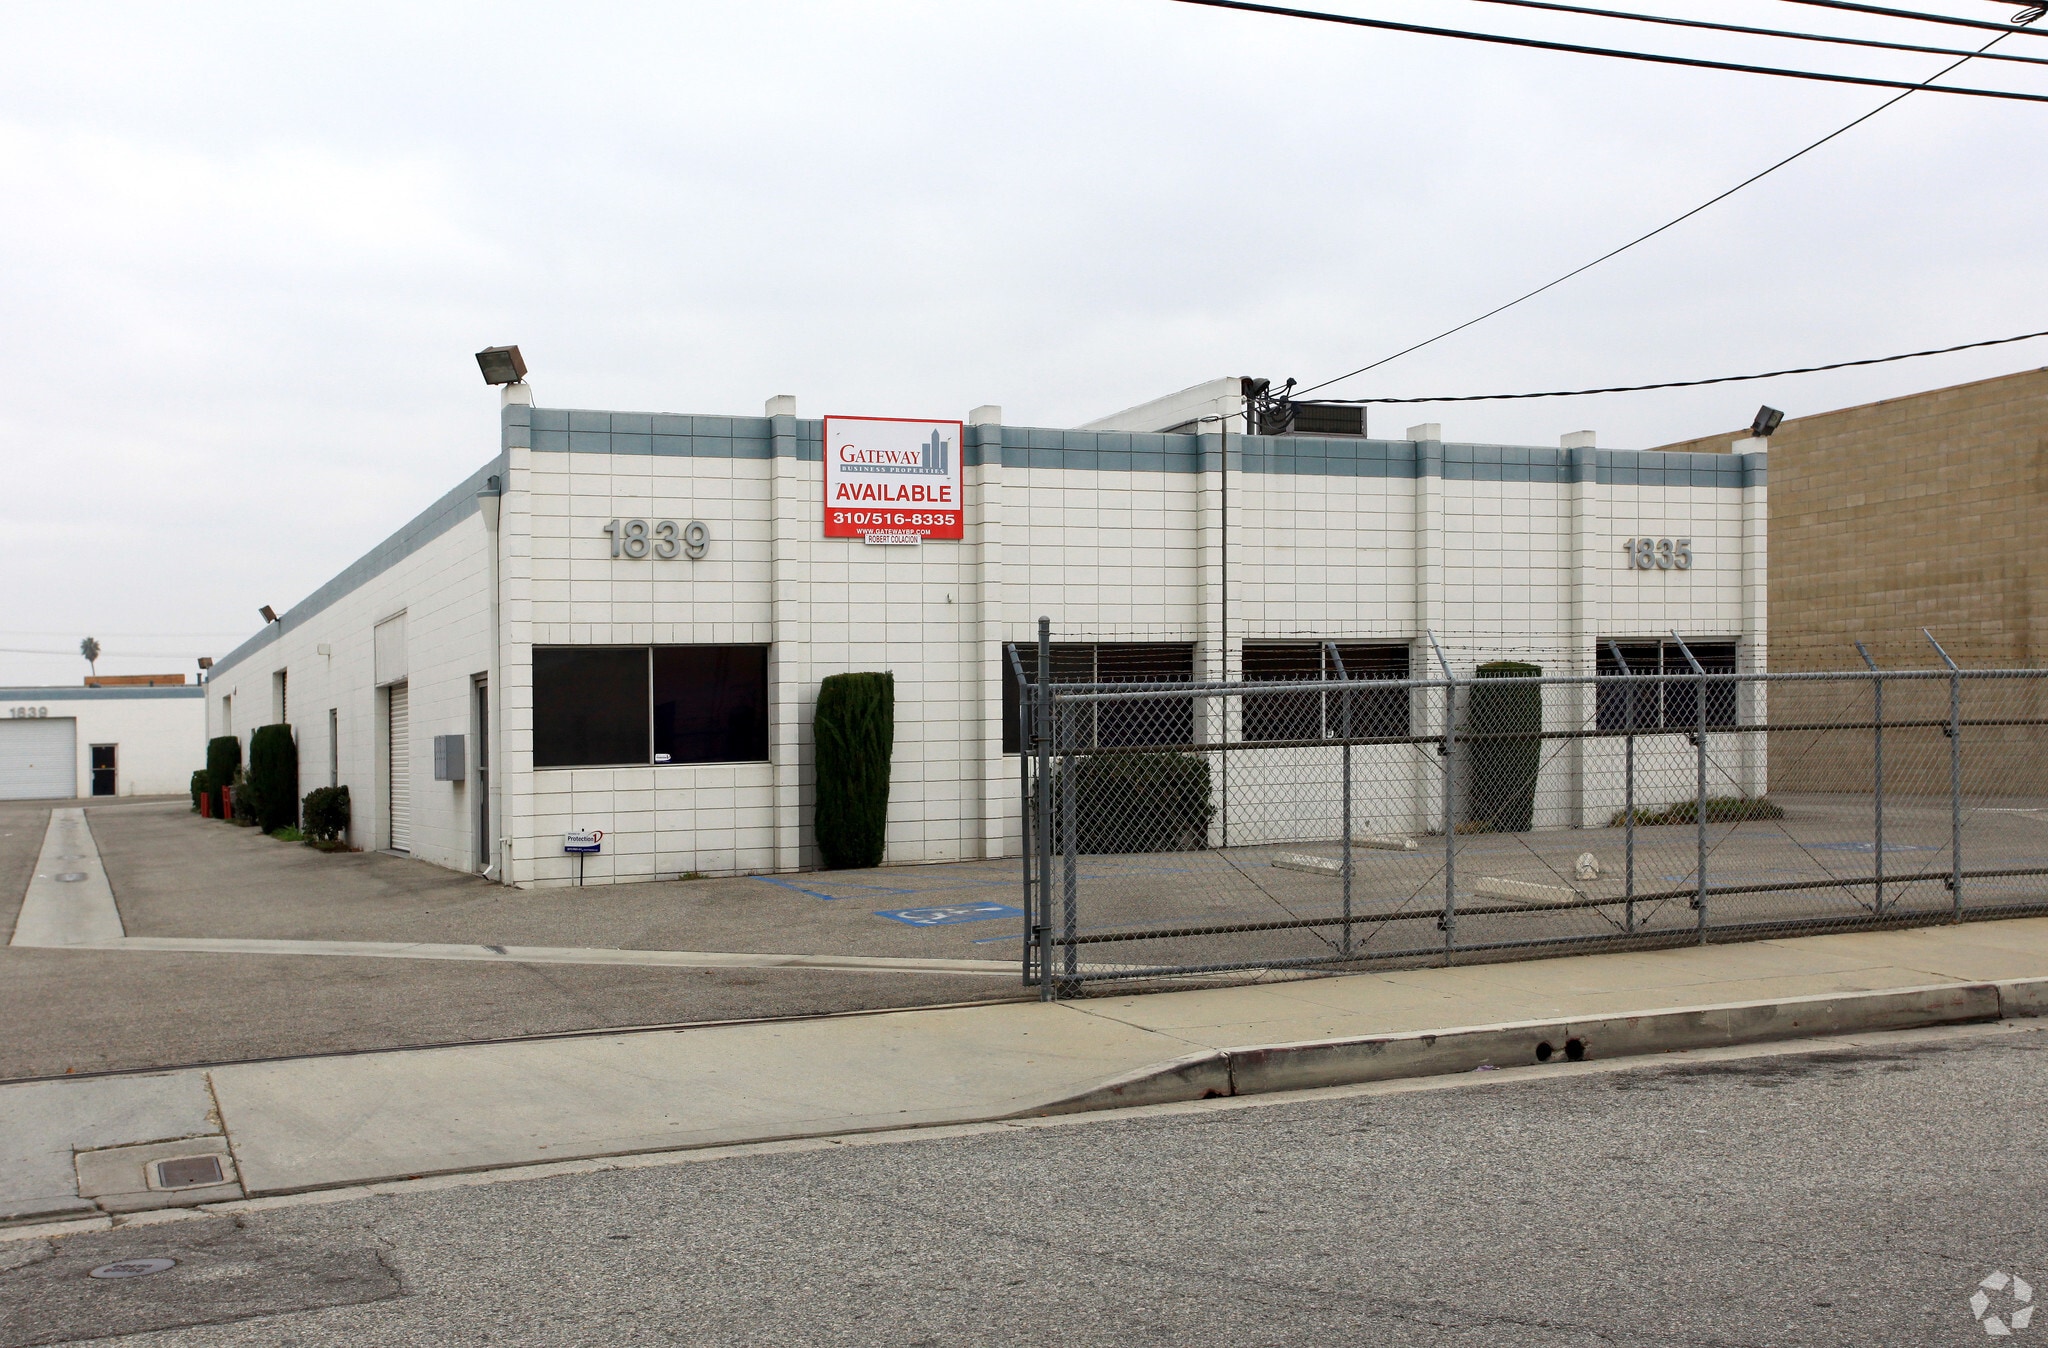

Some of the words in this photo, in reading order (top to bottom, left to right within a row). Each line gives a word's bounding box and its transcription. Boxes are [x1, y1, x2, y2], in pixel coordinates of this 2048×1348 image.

[840, 444, 920, 465] GATEWAY
[836, 483, 952, 502] AVAILABLE
[833, 512, 955, 526] 310/516-8335
[603, 519, 711, 559] 1839
[868, 535, 890, 543] ROBERT
[1623, 538, 1693, 570] 1835
